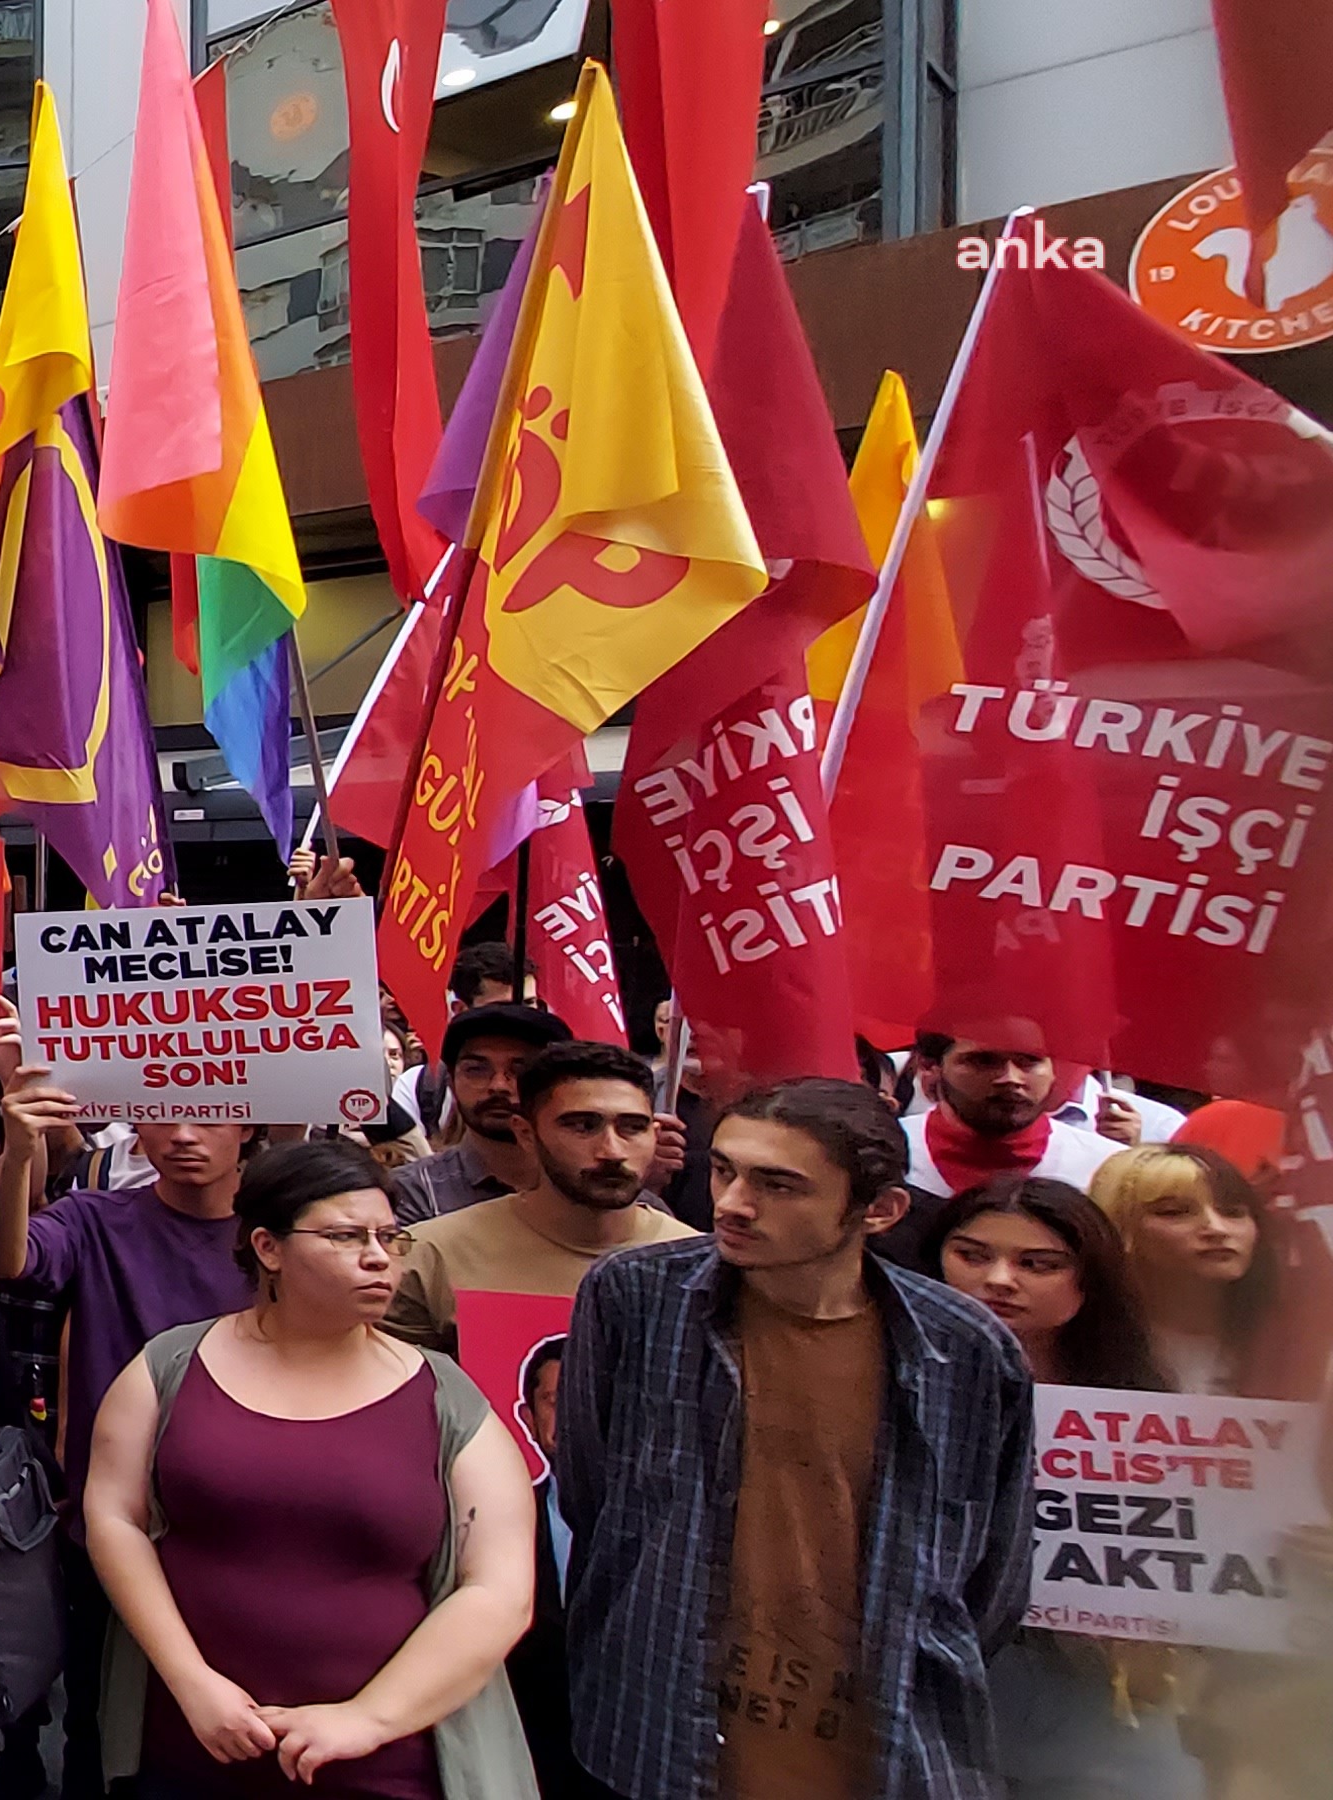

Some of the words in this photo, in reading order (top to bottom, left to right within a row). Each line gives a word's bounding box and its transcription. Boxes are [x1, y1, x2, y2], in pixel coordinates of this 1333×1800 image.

[949, 678, 1333, 792] TÜRKİYE
[1140, 775, 1315, 876] İŞÇİ
[929, 843, 1286, 955] PARTİSİ
[40, 921, 132, 954] CAN
[144, 905, 342, 948] ATALAY
[84, 944, 294, 985] MECLİSE!
[37, 979, 355, 1030] HUKUKSUZ
[38, 1018, 361, 1063] TUTUKLULUĞA
[143, 1059, 248, 1089] SON!
[126, 1101, 167, 1122] İŞÇİ
[171, 1101, 252, 1119] PARTİSİ
[1053, 1409, 1290, 1451] ATALAY
[1034, 1446, 1256, 1490] CLİS'TE
[1034, 1489, 1198, 1540] GEZİ
[1034, 1540, 1289, 1600] AKTA!
